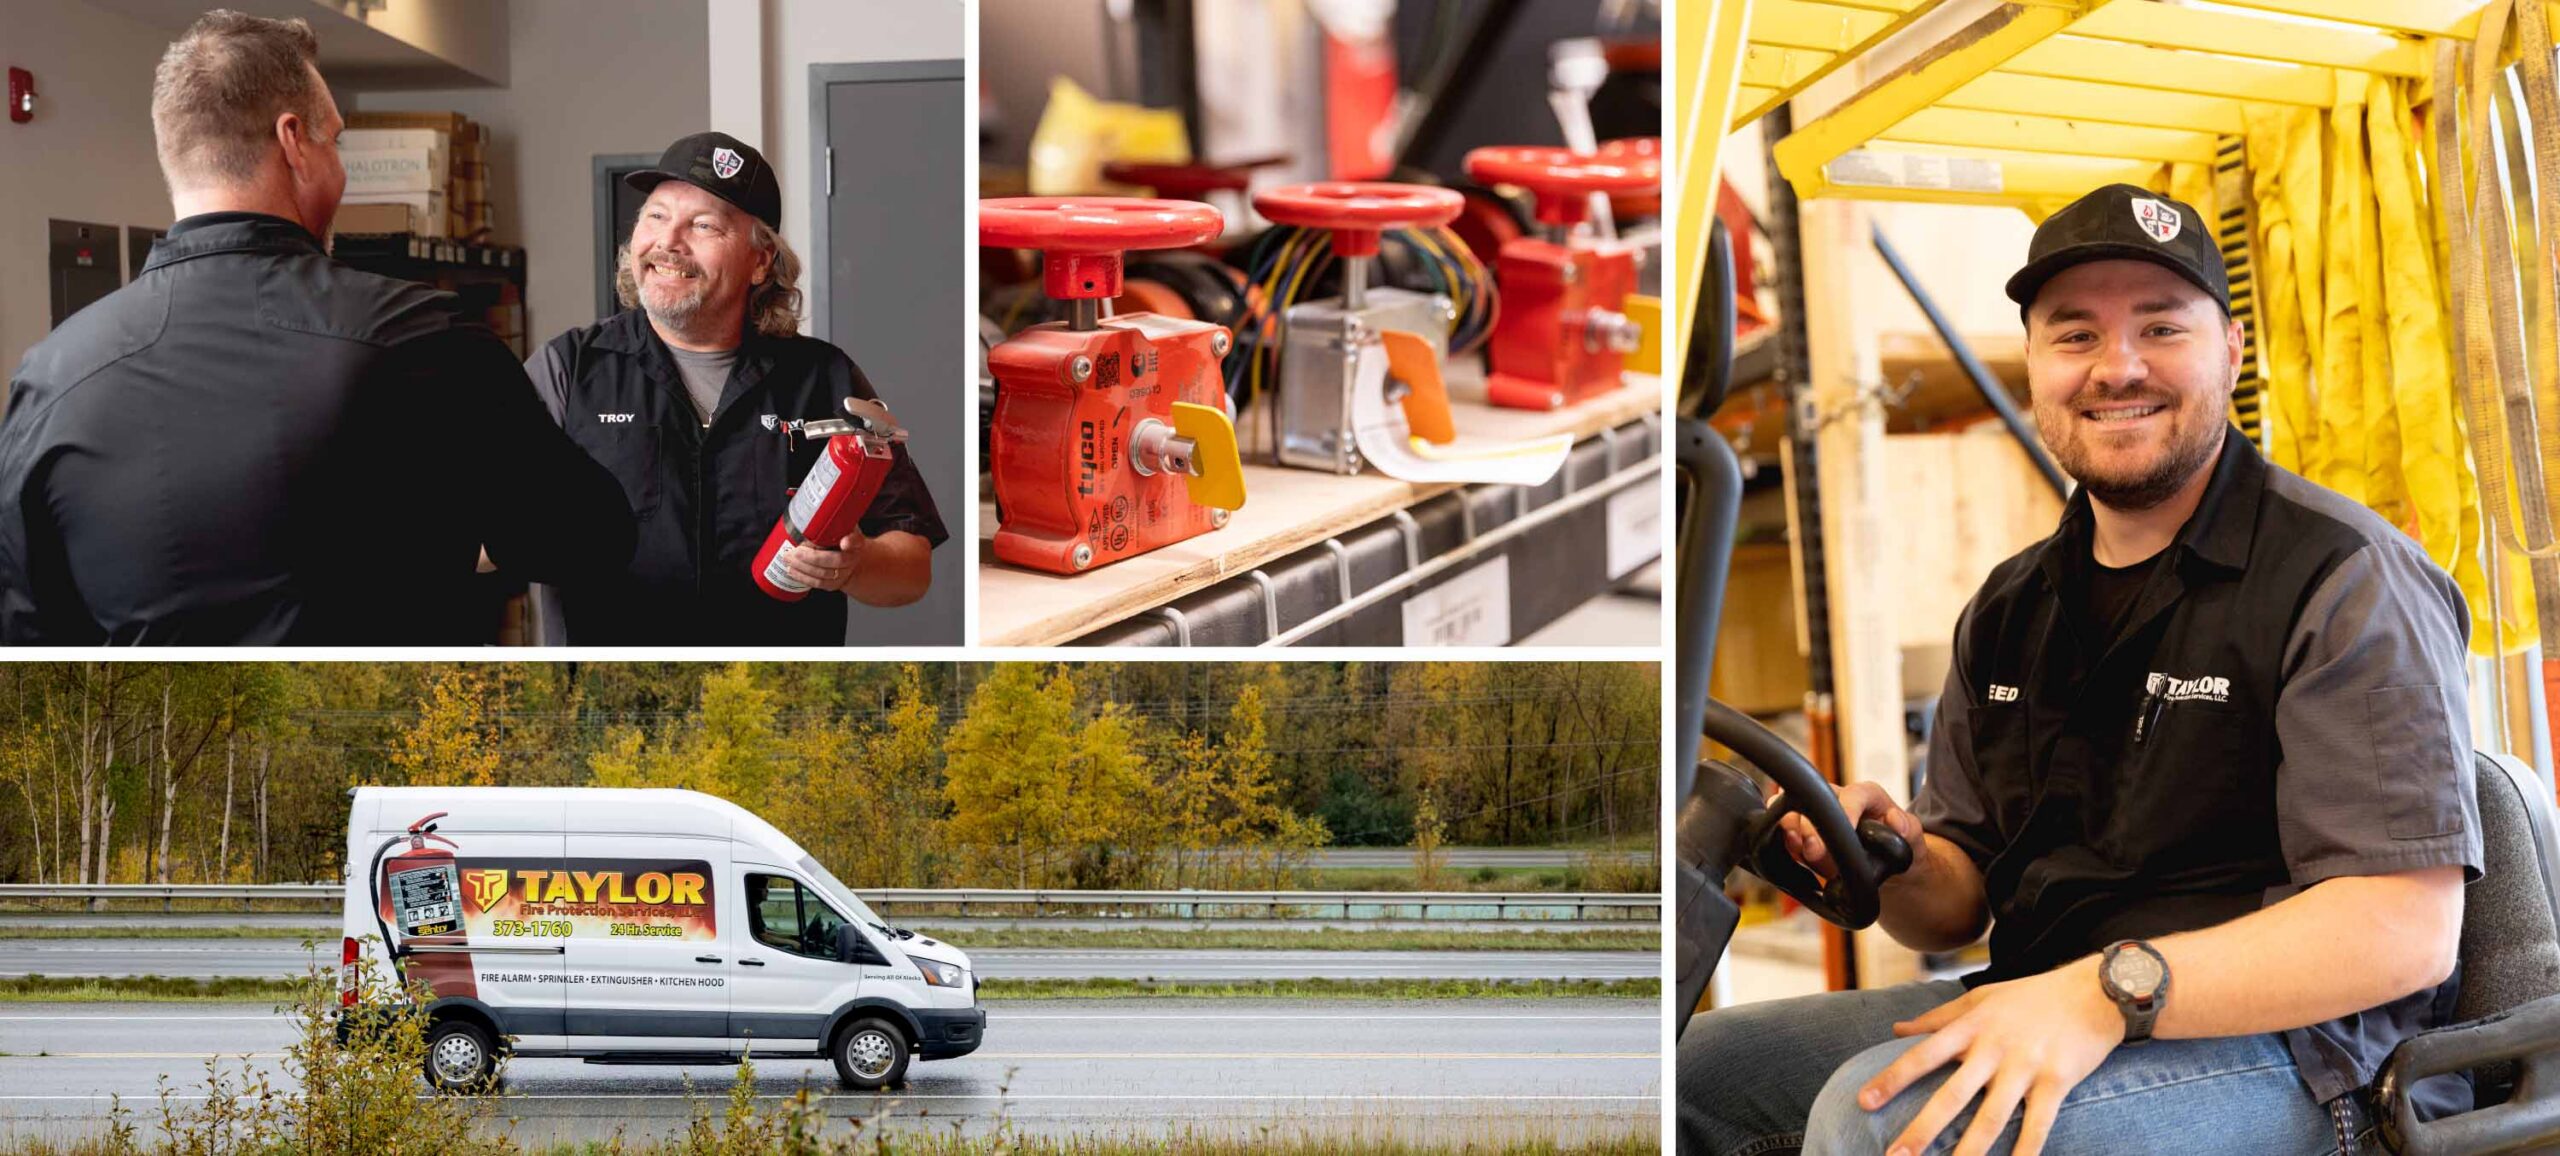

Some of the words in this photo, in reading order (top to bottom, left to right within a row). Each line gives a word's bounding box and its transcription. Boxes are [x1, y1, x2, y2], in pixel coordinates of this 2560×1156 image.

[598, 413, 635, 423] TROY
[1078, 421, 1096, 499] tyco
[2167, 675, 2230, 696] TAYLOR
[517, 871, 706, 904] TAYLOR
[519, 903, 545, 916] Fire
[547, 903, 616, 917] Protection
[618, 904, 676, 918] Services,
[493, 920, 573, 937] 373-1760
[610, 923, 626, 936] 24
[626, 923, 643, 936] Hr.
[643, 923, 683, 937] Service
[481, 973, 499, 983] FIRE
[501, 974, 532, 984] ALARM
[538, 974, 585, 985] SPRINKLER
[590, 975, 654, 987] EXTINGUISHER
[659, 977, 697, 988] KITCHEN
[698, 978, 725, 988] HOOD
